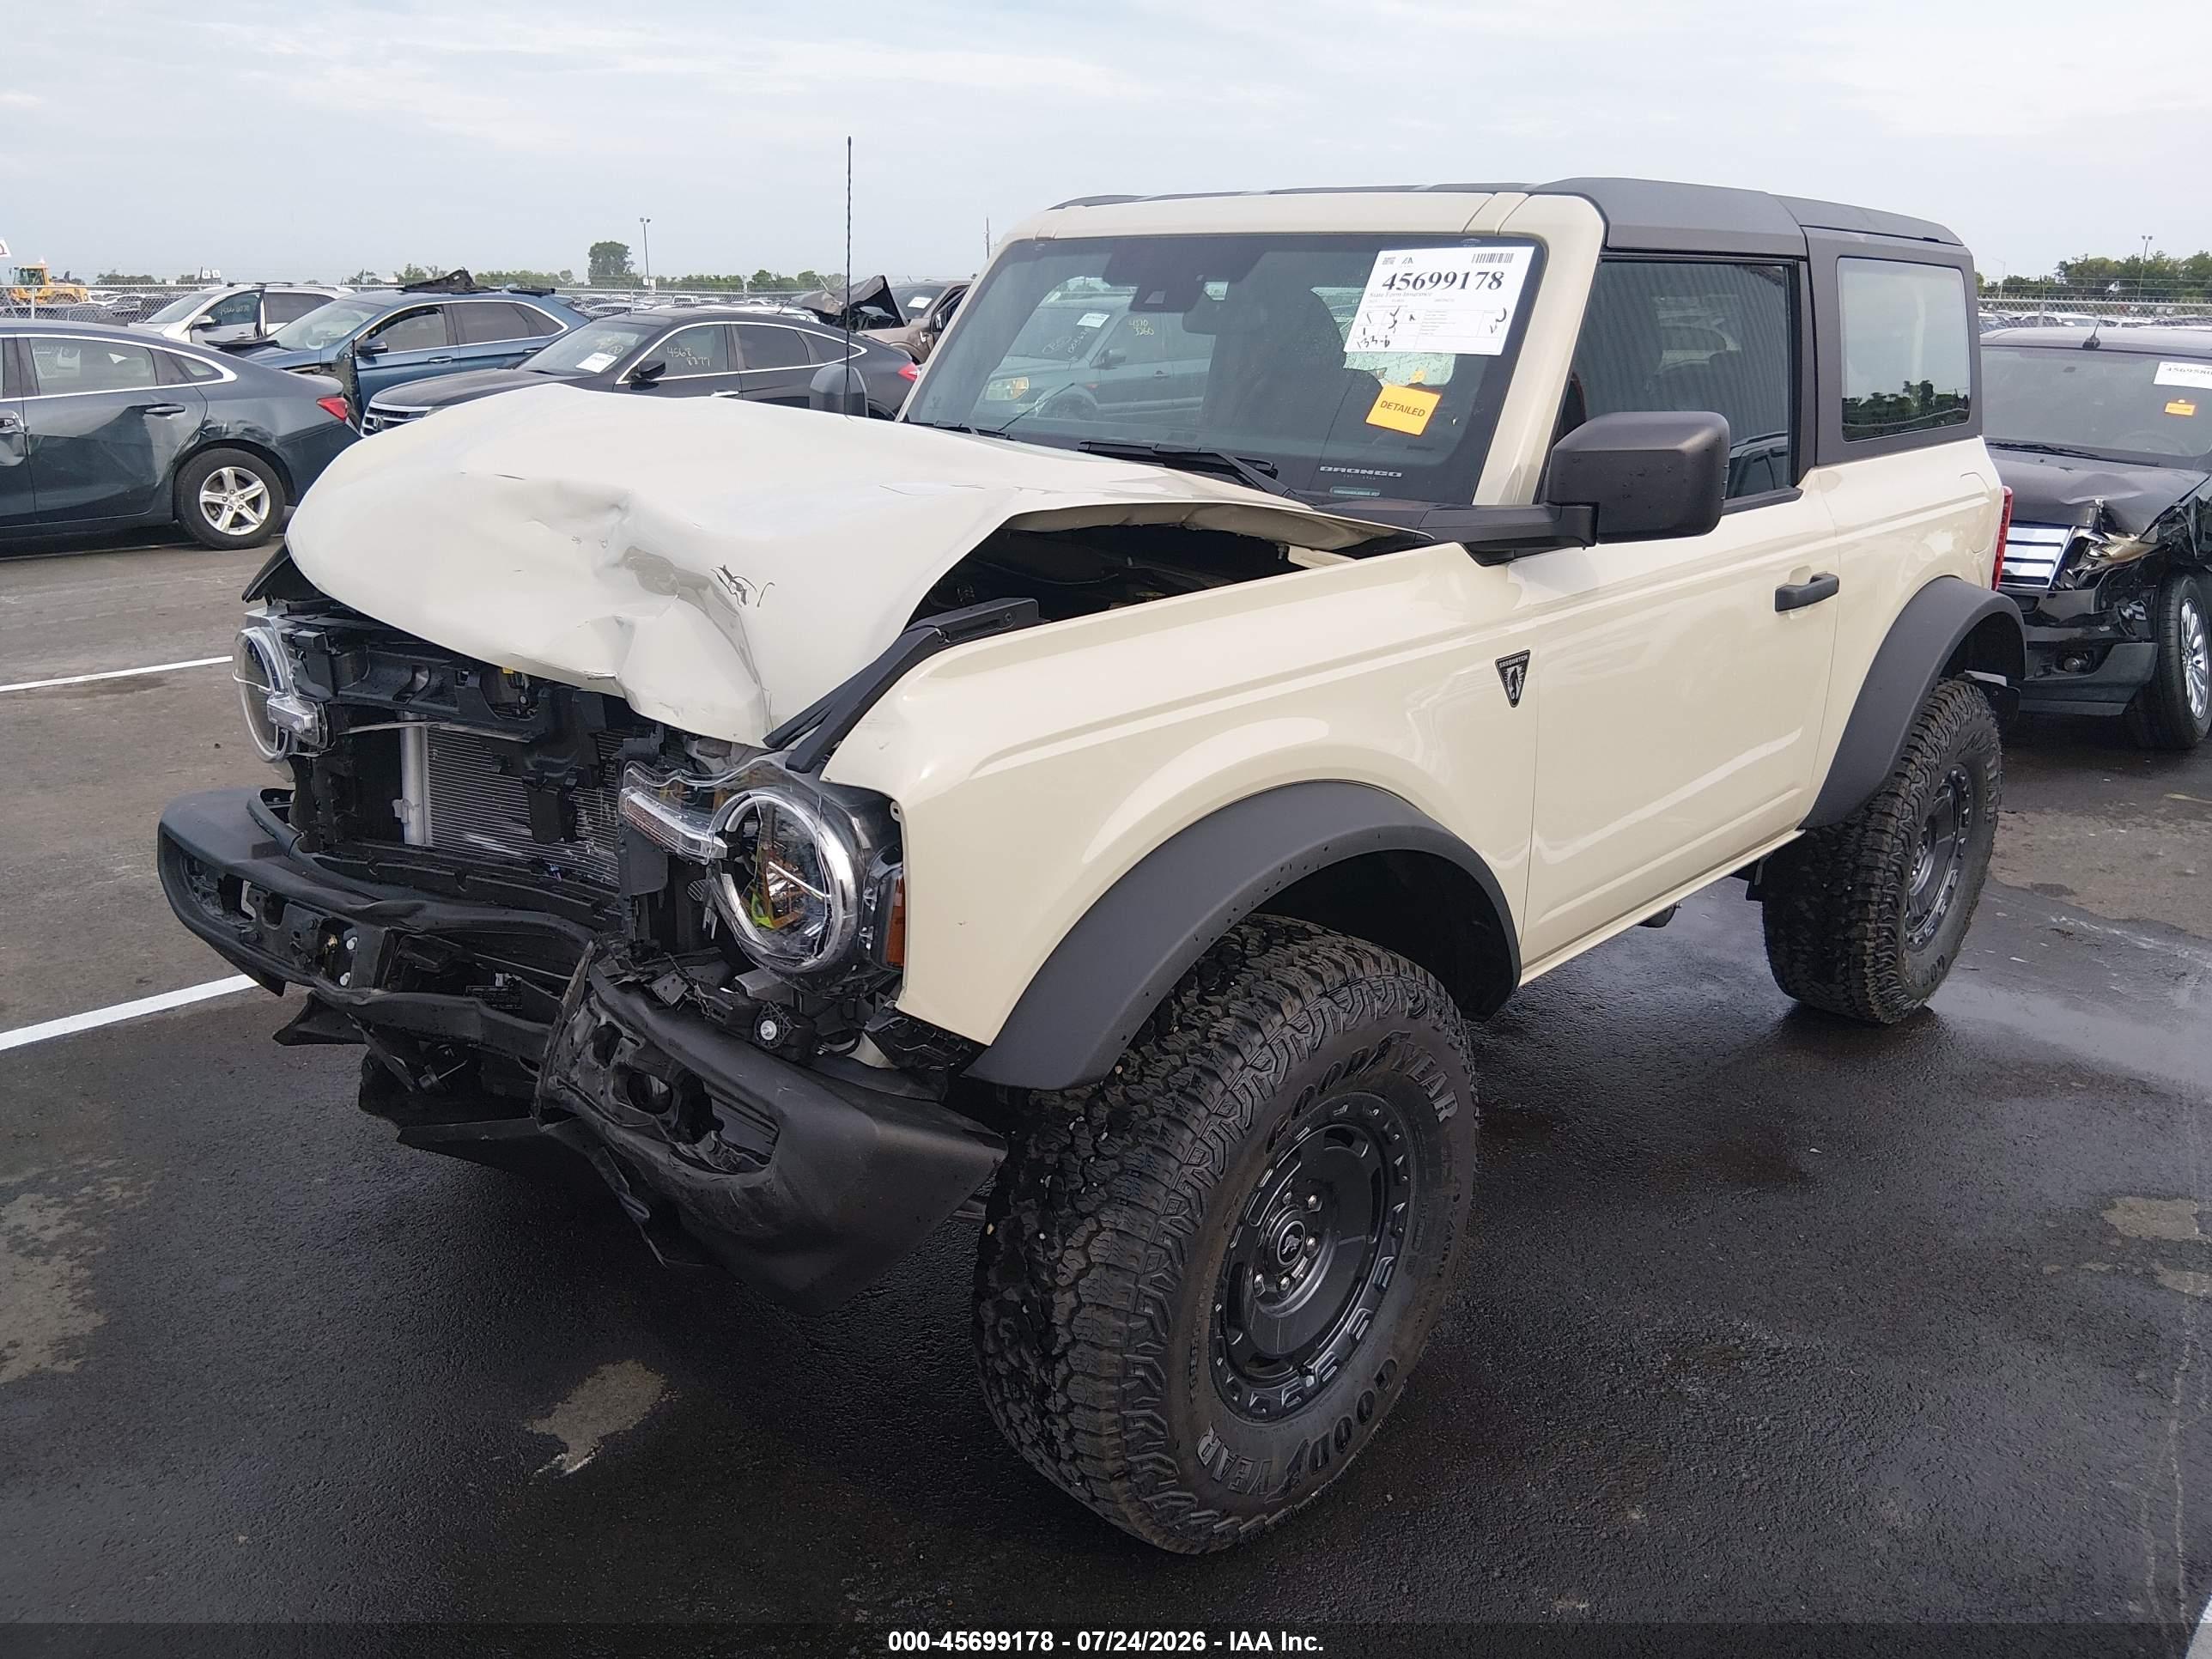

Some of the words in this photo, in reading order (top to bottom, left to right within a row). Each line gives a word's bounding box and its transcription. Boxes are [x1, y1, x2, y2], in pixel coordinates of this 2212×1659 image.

[1382, 270, 1504, 291] 45699178
[1380, 399, 1426, 417] DETAILED
[1319, 466, 1402, 477] BRONCO
[1498, 654, 1528, 668] SASQUATCH
